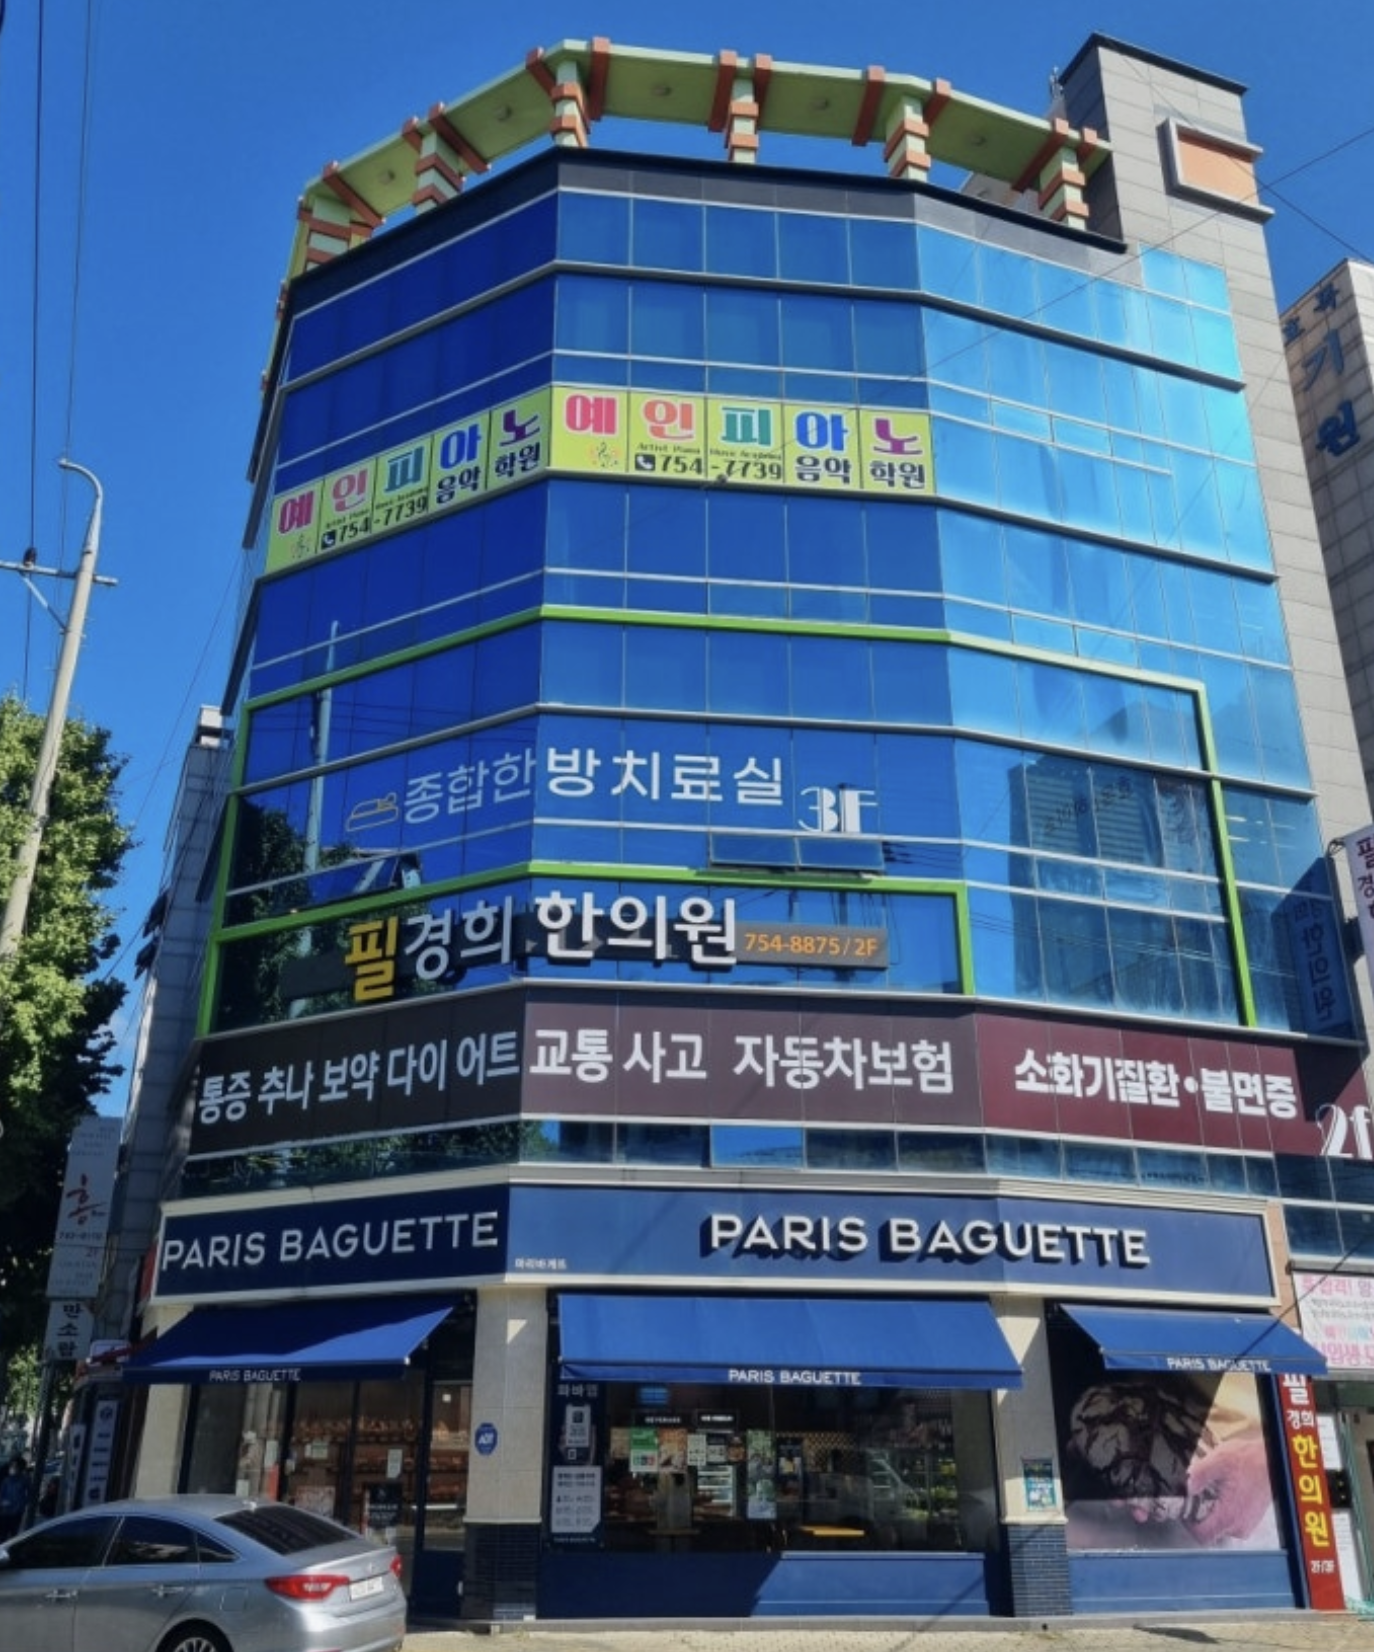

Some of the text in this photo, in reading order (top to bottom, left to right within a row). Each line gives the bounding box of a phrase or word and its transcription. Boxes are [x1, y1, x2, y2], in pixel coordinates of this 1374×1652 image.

[564, 393, 924, 456] 예인피아노
[278, 409, 542, 534] 예인피아노
[494, 442, 541, 478] 학원
[660, 454, 782, 480] 754-7739
[794, 456, 852, 485] 음악
[869, 459, 926, 489] 학원
[436, 466, 482, 504] 음악
[339, 495, 429, 542] 754-7739
[529, 1027, 955, 1095] 교통 사고 자동차보험
[198, 1070, 252, 1126] 통증
[257, 1060, 315, 1117] 추나
[318, 1050, 381, 1102] 보약
[162, 1210, 498, 1272] PARIS BAGUETTE
[709, 1212, 1151, 1265] PARIS BAGUETTE
[209, 1368, 302, 1382] PARIS BAGUETTE
[729, 1368, 862, 1386] PARIS BAGUETTE
[1166, 1357, 1272, 1373] PARIS BAGUETTE
[1286, 1410, 1315, 1431] 경희
[1291, 1434, 1331, 1548] 한의원
